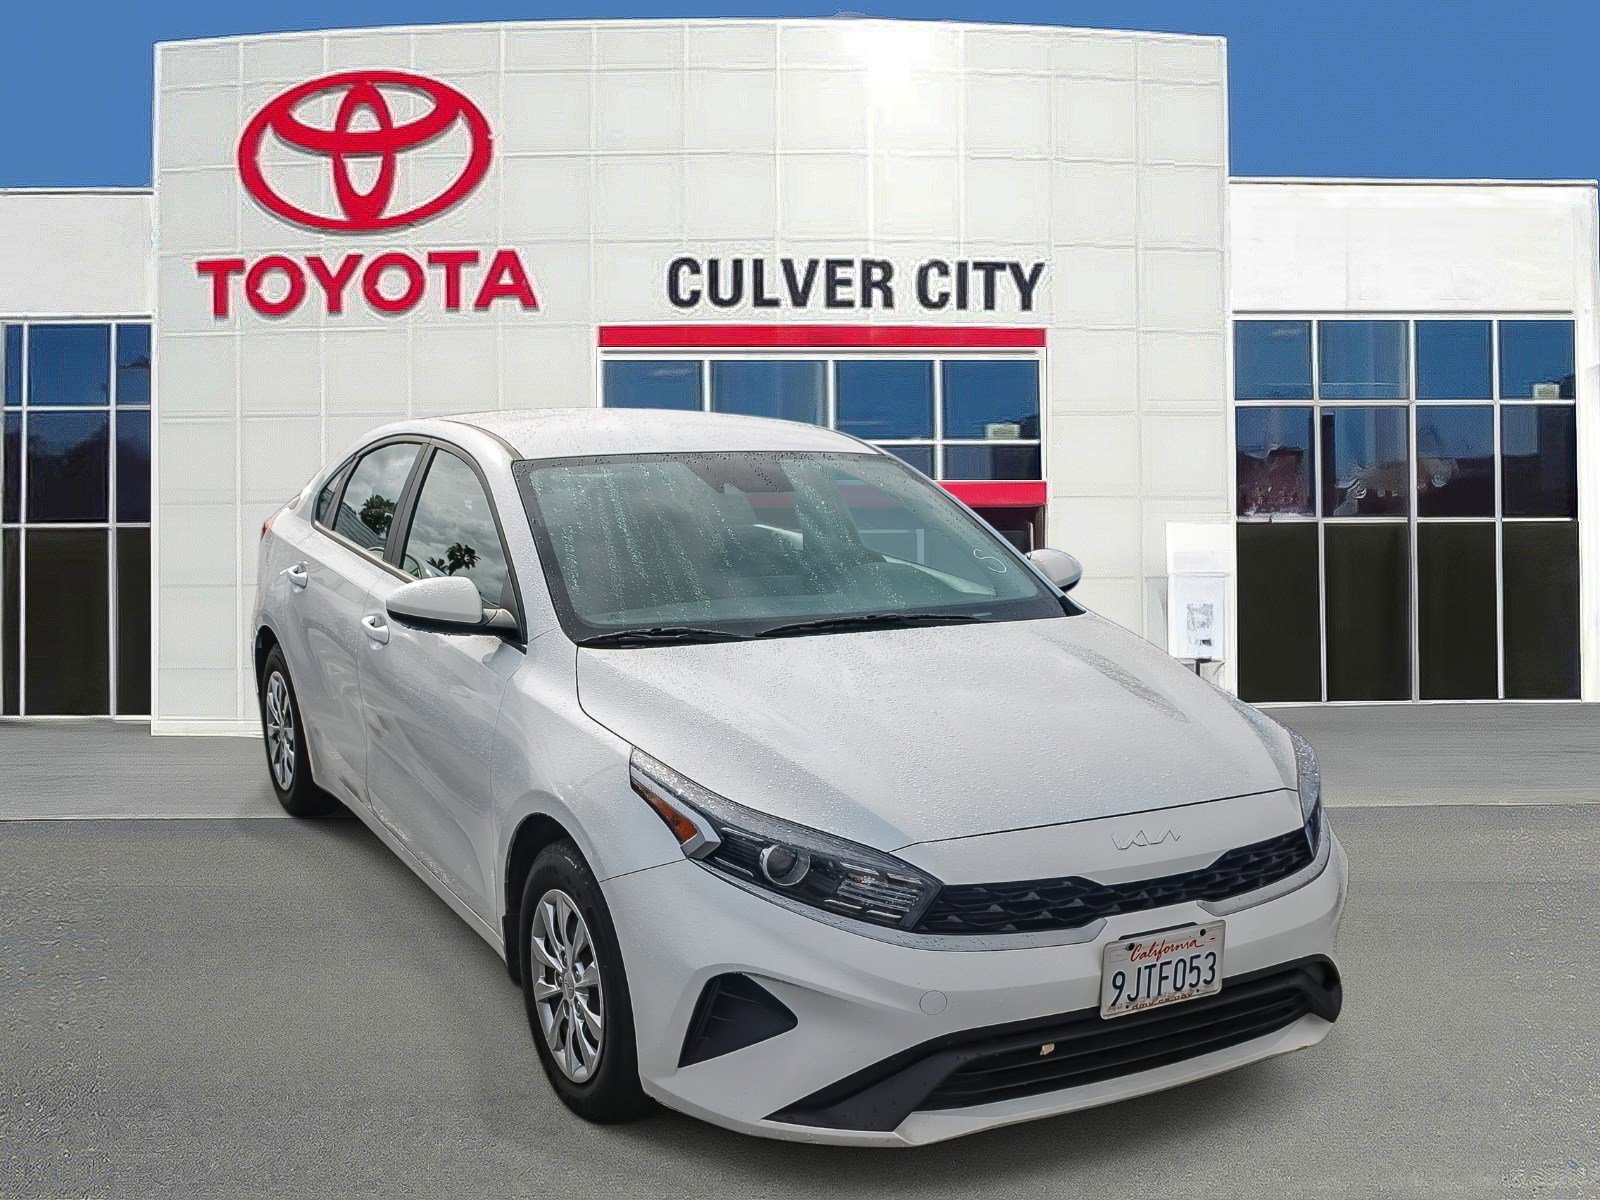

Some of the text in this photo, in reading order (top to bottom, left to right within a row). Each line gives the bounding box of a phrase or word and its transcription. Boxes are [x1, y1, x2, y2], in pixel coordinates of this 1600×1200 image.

[196, 250, 539, 318] TOYOTA
[667, 257, 1045, 311] CULVER CITY
[1130, 939, 1204, 962] California
[1110, 951, 1217, 1007] 9JTF053
